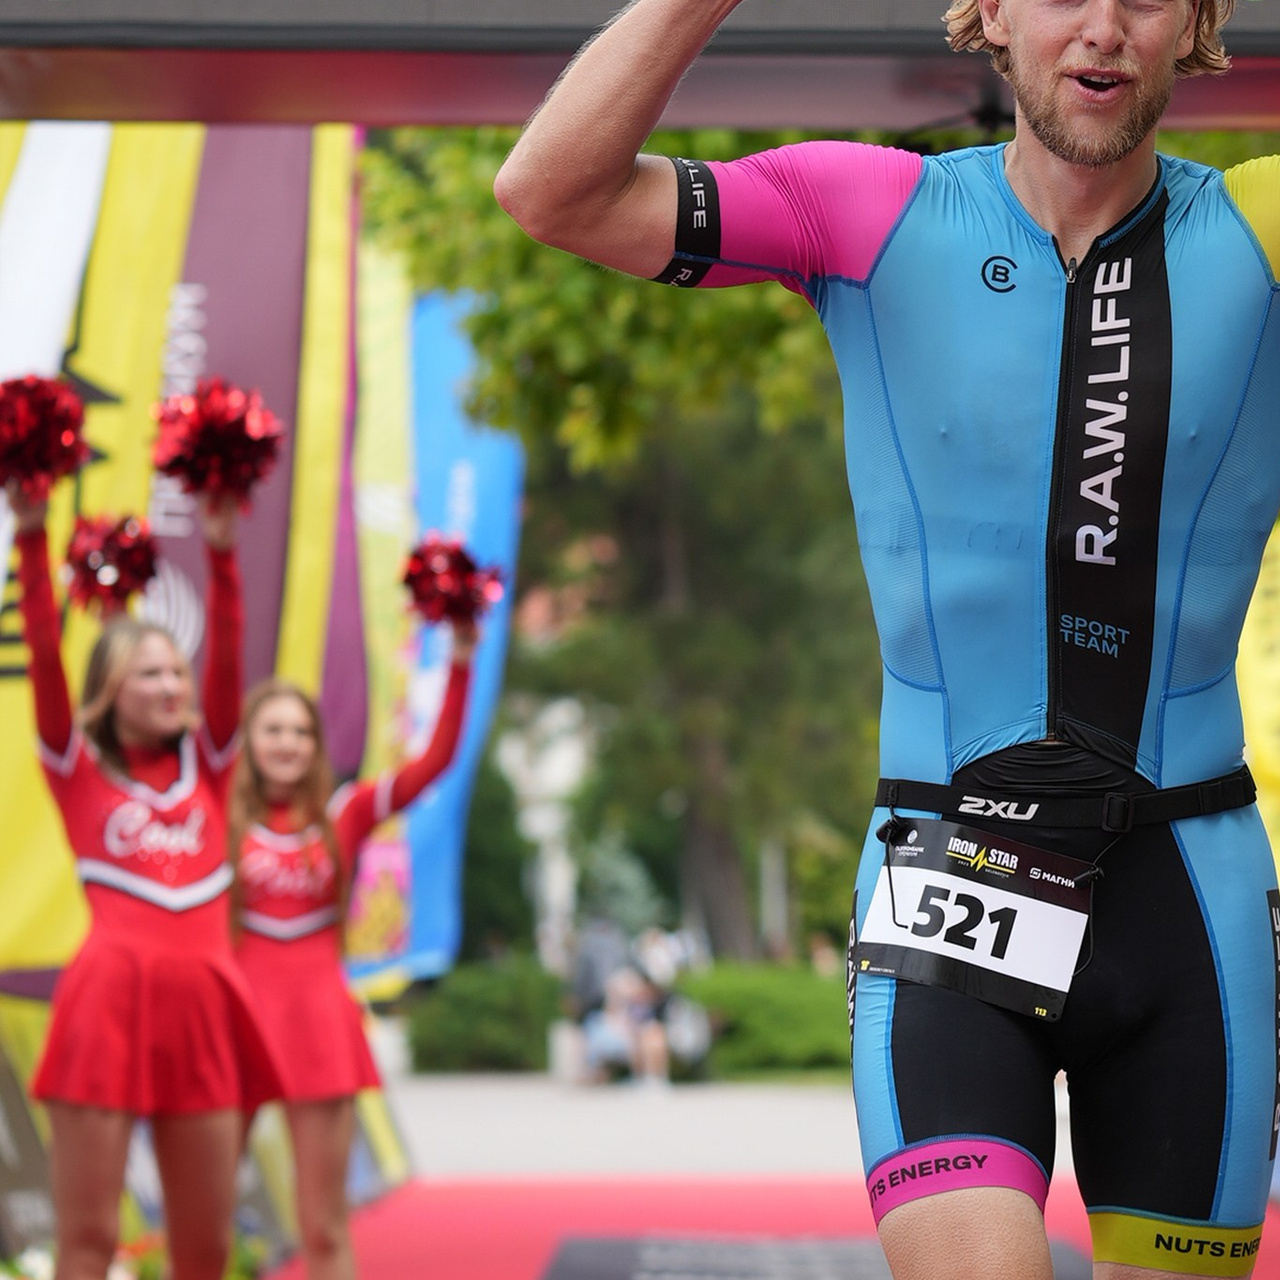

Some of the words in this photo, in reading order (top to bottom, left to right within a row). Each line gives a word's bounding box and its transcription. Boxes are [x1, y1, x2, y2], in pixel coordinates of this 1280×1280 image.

[1074, 256, 1134, 566] R.A.W.LIFE
[1060, 613, 1131, 646] SPORT
[1060, 628, 1119, 659] TEAM
[957, 795, 1040, 821] 2XU
[946, 836, 978, 858] IRON
[987, 848, 1020, 870] STAR
[1041, 871, 1076, 889] МАГНИ
[910, 884, 1018, 960] 521
[888, 1154, 989, 1189] ENERGY
[1154, 1232, 1226, 1258] NUTS
